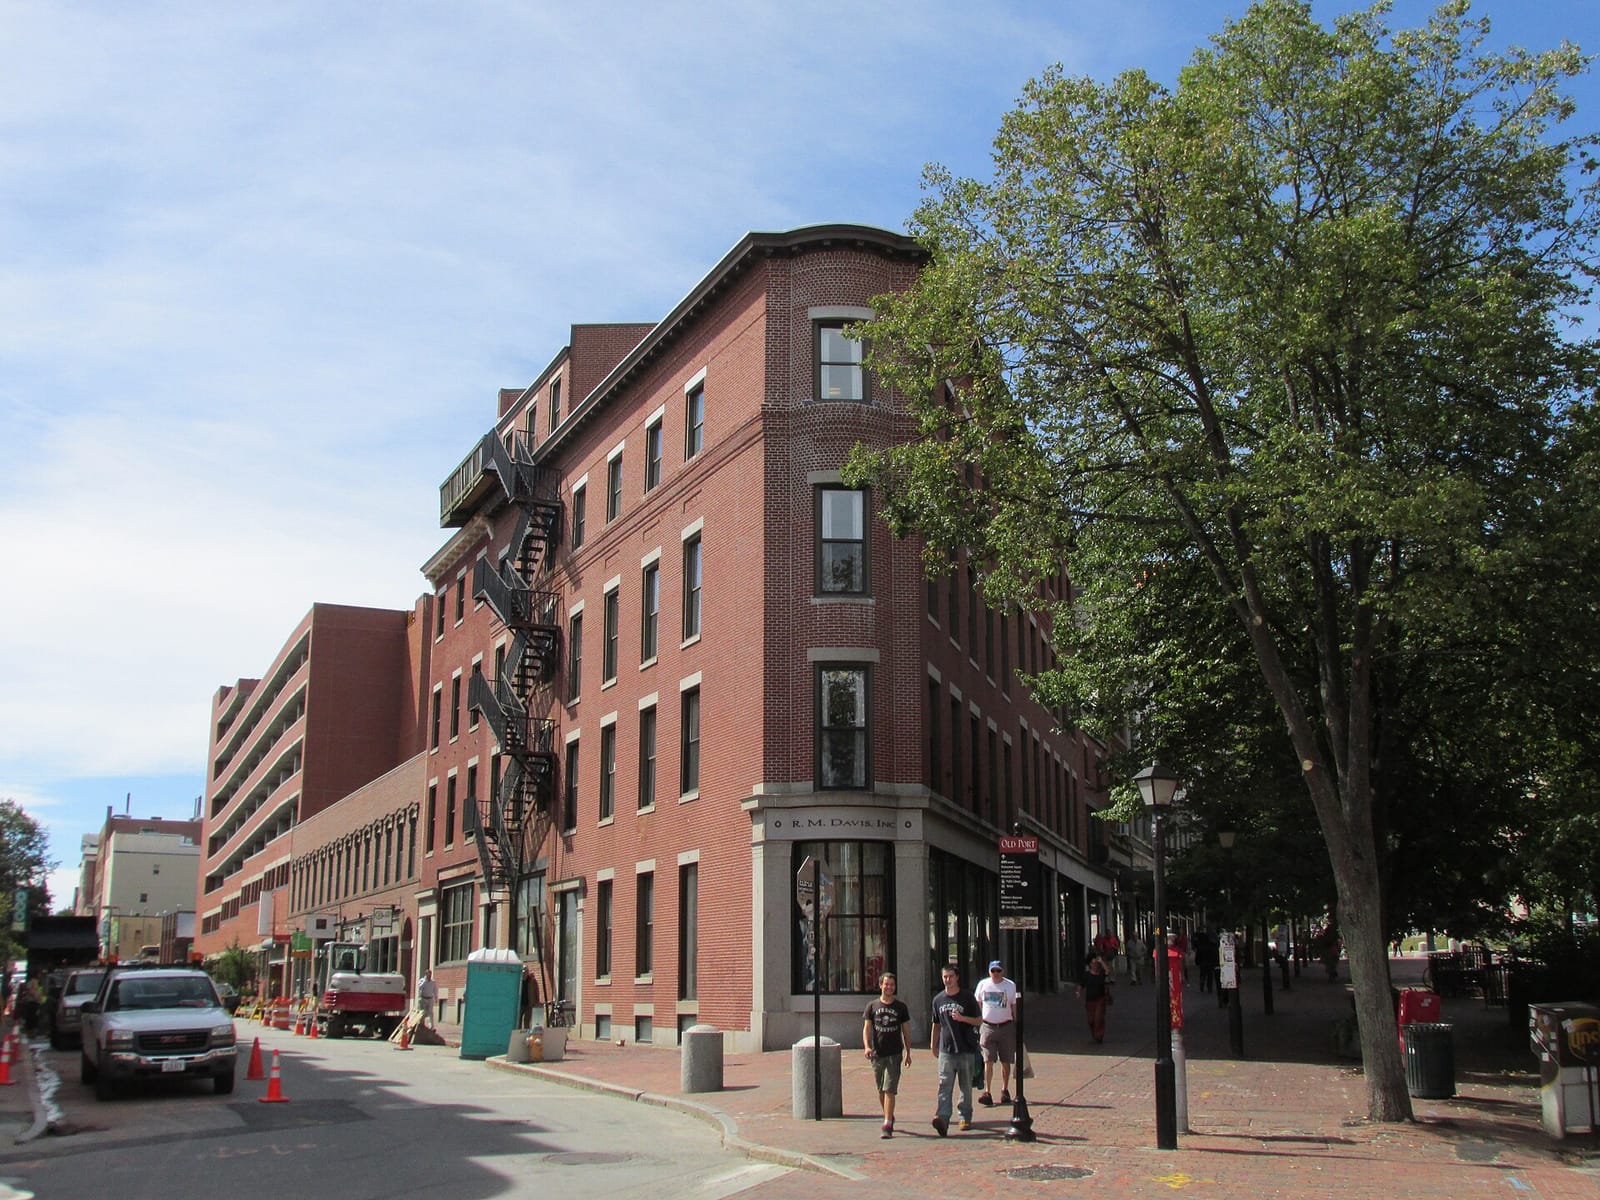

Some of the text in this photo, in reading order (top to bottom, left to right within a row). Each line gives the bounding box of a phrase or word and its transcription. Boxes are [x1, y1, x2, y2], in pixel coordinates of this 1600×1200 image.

[792, 820, 804, 828] R.
[807, 819, 826, 827] M.
[1001, 839, 1036, 849] OLD PORT
